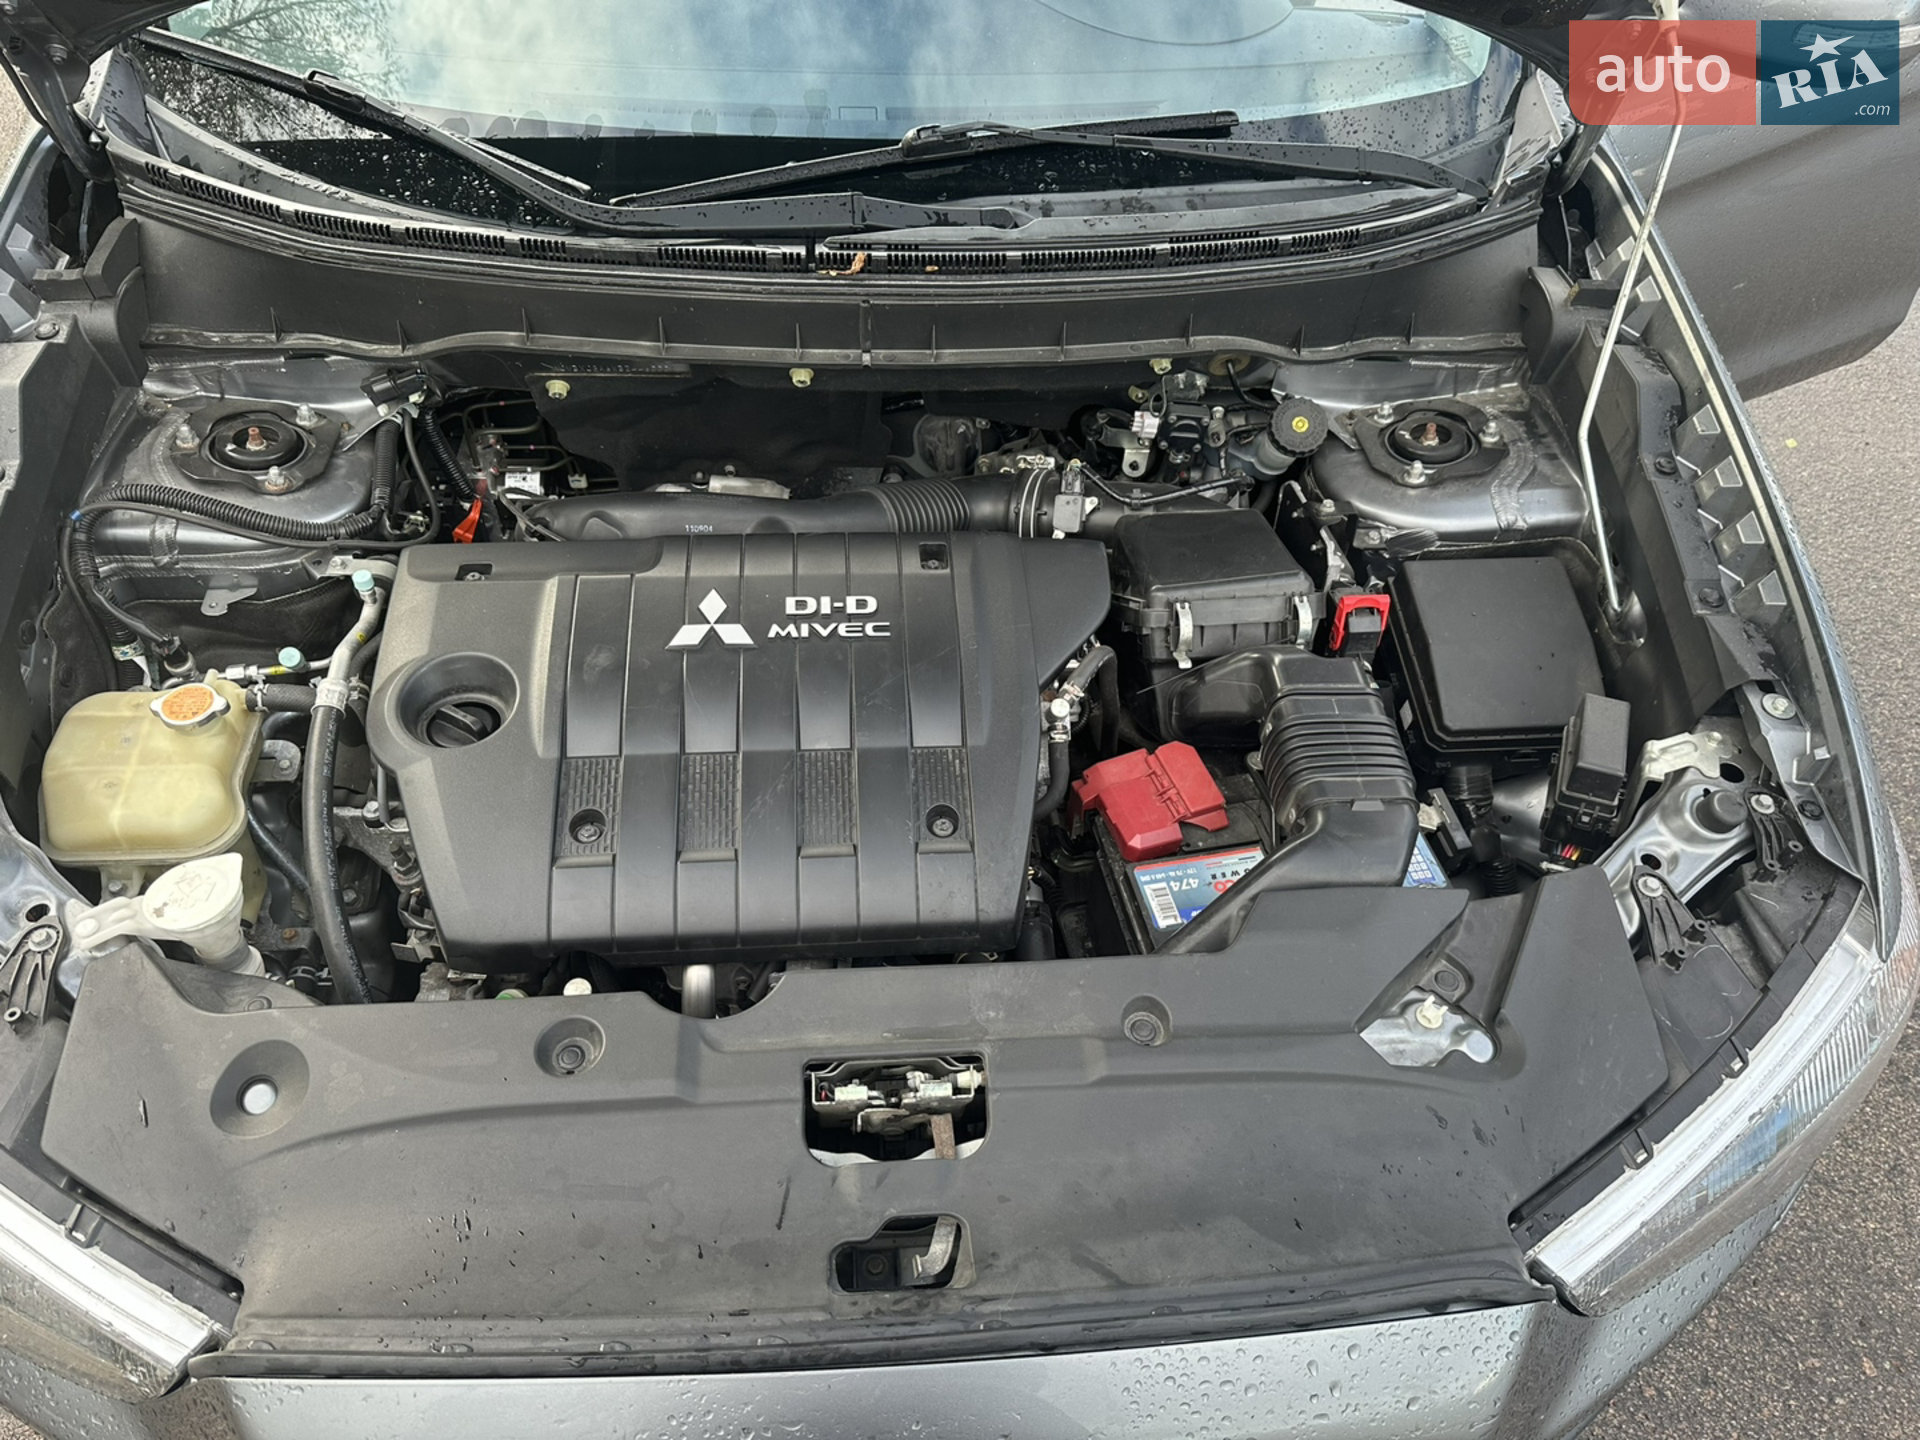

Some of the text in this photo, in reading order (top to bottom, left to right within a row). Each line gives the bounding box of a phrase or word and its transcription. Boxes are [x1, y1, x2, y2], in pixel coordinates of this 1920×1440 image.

[785, 595, 878, 615] DI-D
[767, 622, 891, 638] MIVEC
[1170, 878, 1200, 892] 474
